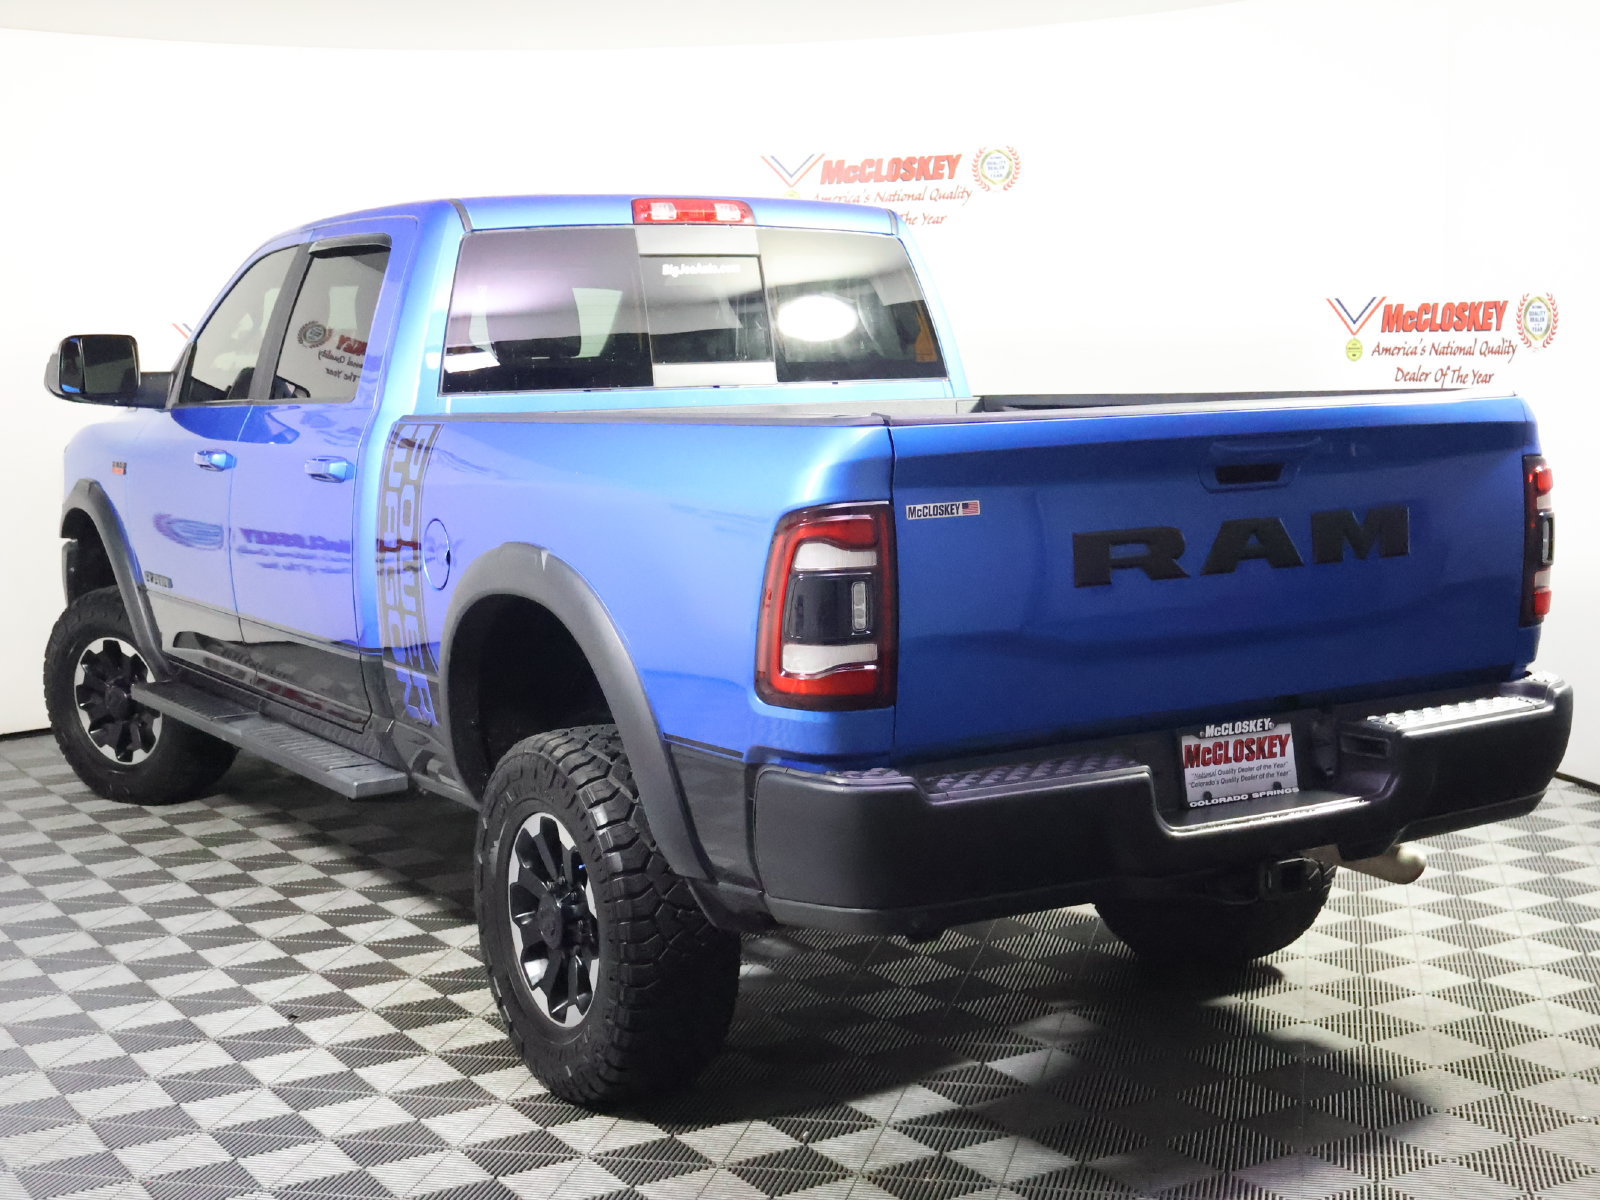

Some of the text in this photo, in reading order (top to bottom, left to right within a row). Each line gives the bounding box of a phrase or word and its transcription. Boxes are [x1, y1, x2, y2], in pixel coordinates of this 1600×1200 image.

[820, 153, 962, 185] McCLOSKEY
[874, 188, 926, 203] National
[930, 185, 973, 206] Quality
[921, 213, 948, 225] Year
[1381, 300, 1509, 333] McCLOSKEY
[1371, 338, 1426, 357] America's
[1429, 338, 1475, 357] National
[1479, 339, 1518, 363] Quality
[1394, 364, 1495, 388] Dealer Of The Year
[907, 503, 961, 519] McCLOSKEY
[1072, 505, 1410, 588] RAM
[1205, 717, 1271, 738] McCLOSKEY
[1184, 733, 1291, 769] McCLOSKEY
[1189, 786, 1300, 808] COLORADO SPRINGS
